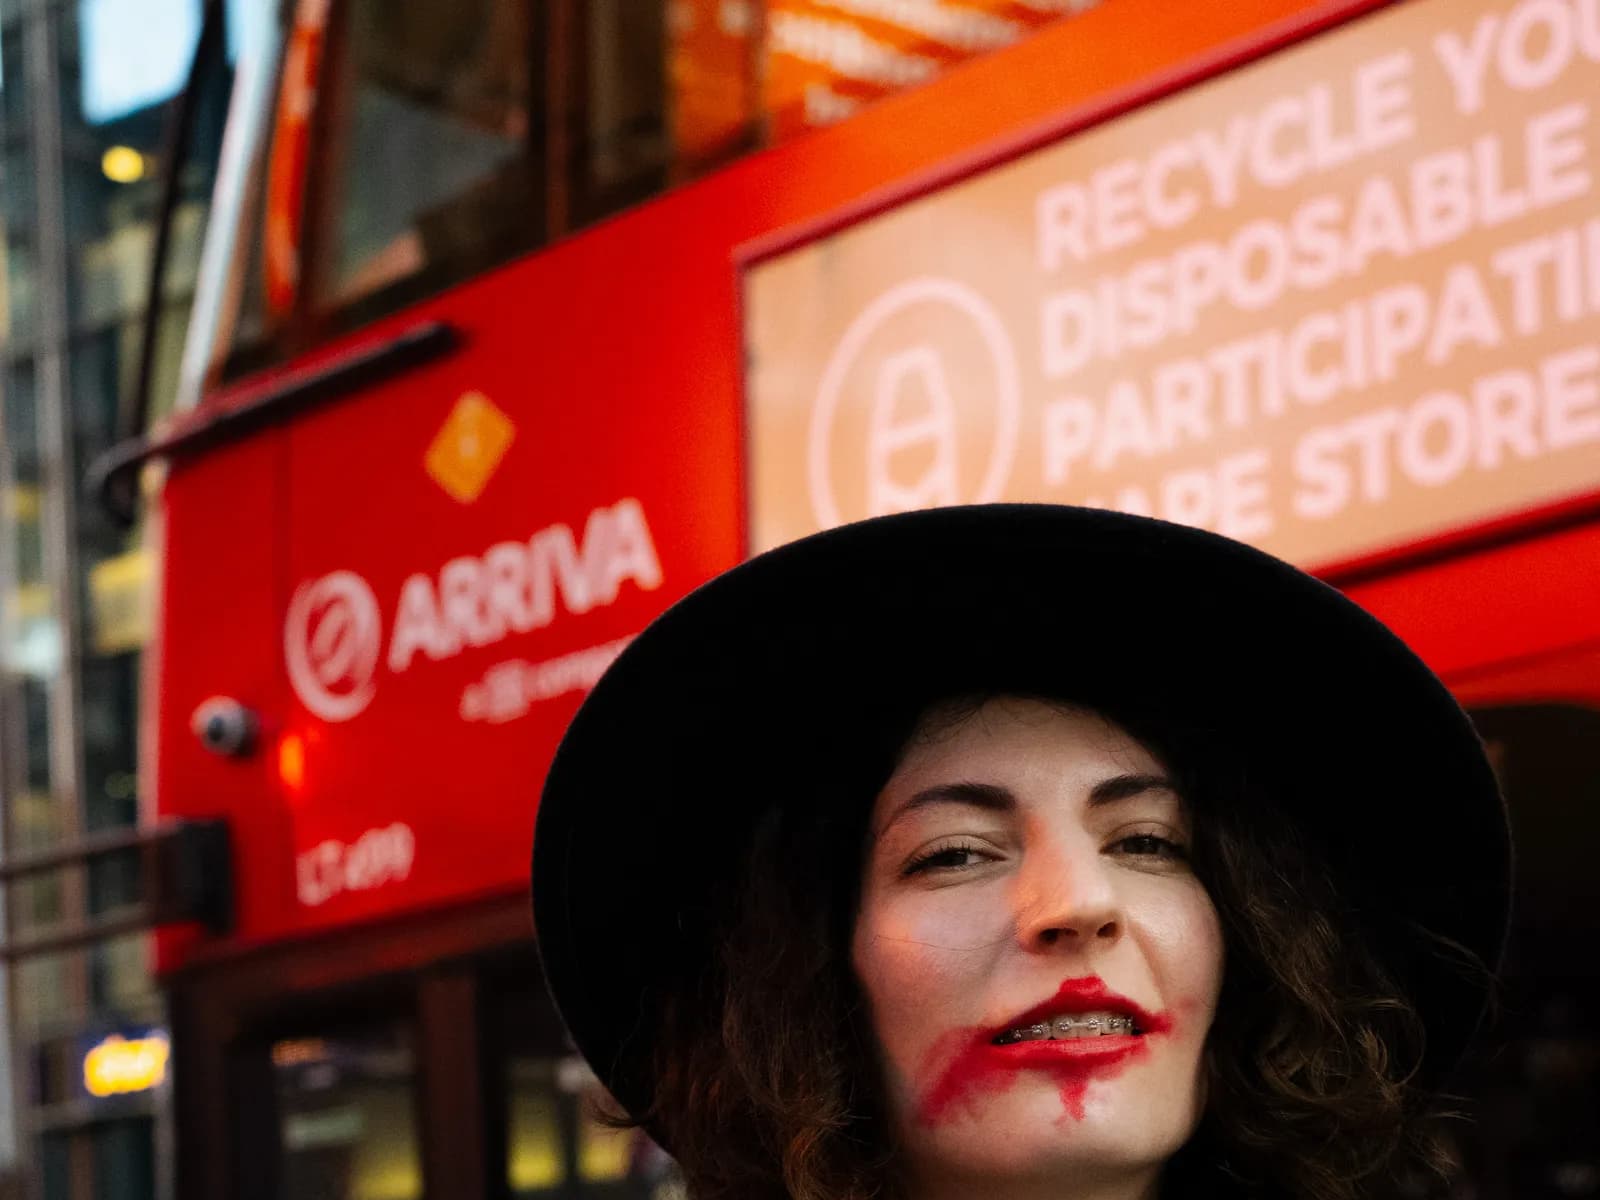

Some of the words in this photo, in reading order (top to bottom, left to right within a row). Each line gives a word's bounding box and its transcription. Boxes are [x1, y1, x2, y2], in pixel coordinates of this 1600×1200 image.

[1034, 52, 1416, 270] RECYCLE
[1042, 101, 1591, 375] DISPOSABLE
[1046, 217, 1600, 487] PARTICIPATI
[388, 498, 663, 673] ARRIVA
